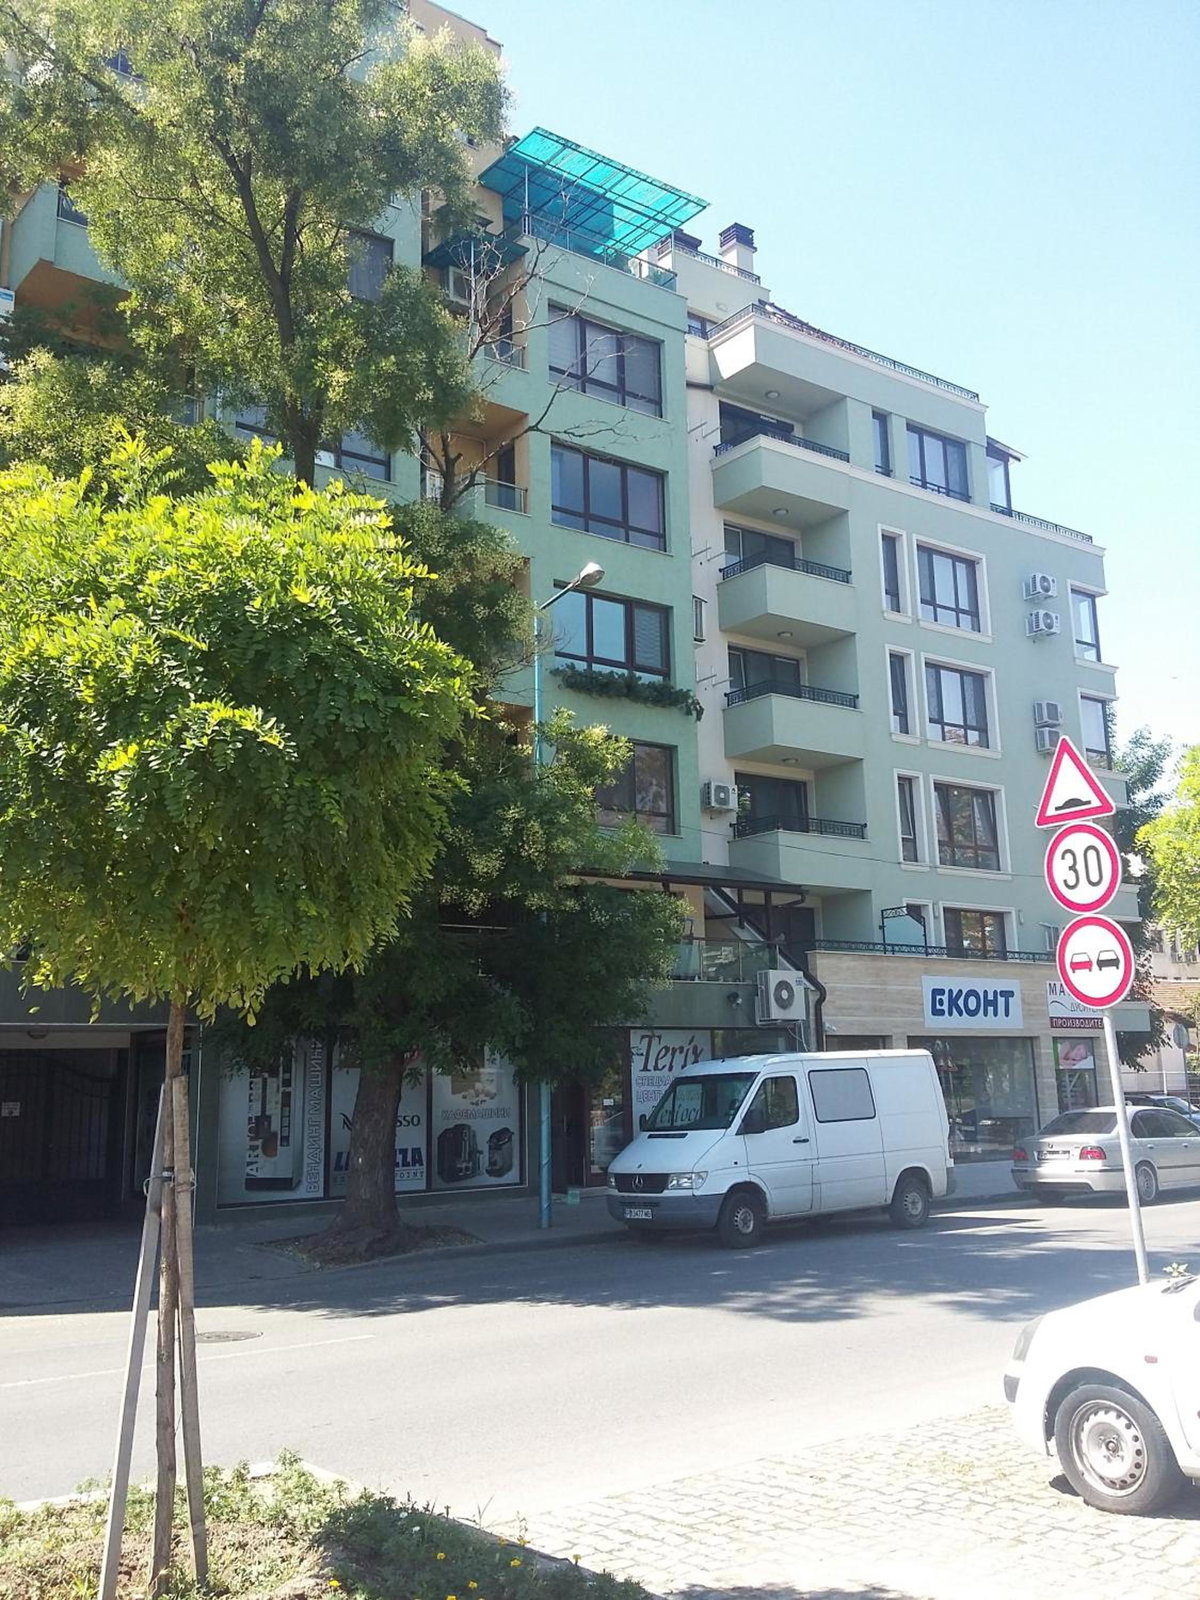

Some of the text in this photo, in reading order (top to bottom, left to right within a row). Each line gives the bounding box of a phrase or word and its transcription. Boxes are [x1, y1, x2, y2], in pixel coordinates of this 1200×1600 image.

[1060, 844, 1104, 890] 30
[930, 987, 1015, 1018] ЕКОНТ
[306, 1117, 322, 1193] ВЕНДИНГ
